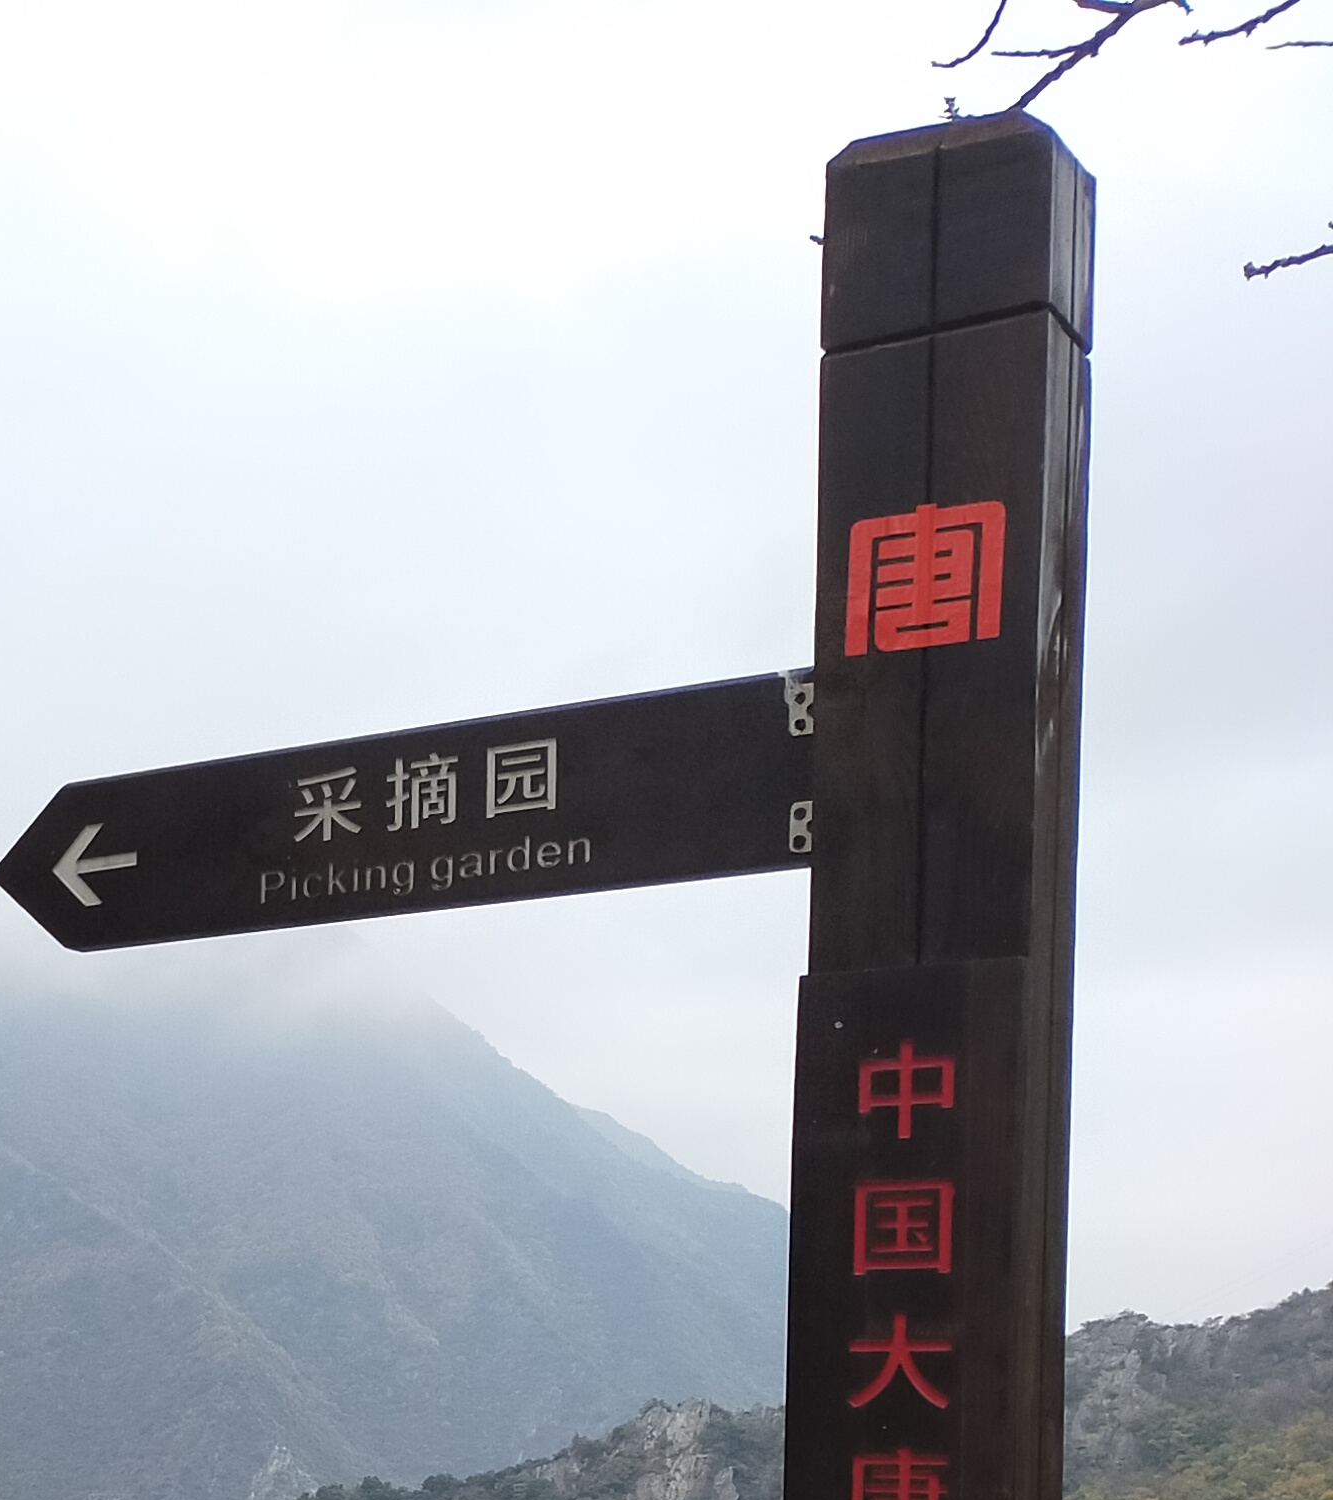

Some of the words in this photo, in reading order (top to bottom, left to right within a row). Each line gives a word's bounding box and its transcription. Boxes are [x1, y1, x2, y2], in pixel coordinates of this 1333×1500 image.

[293, 737, 557, 842] 采摘园
[259, 858, 415, 904] Picking
[431, 835, 591, 892] garden
